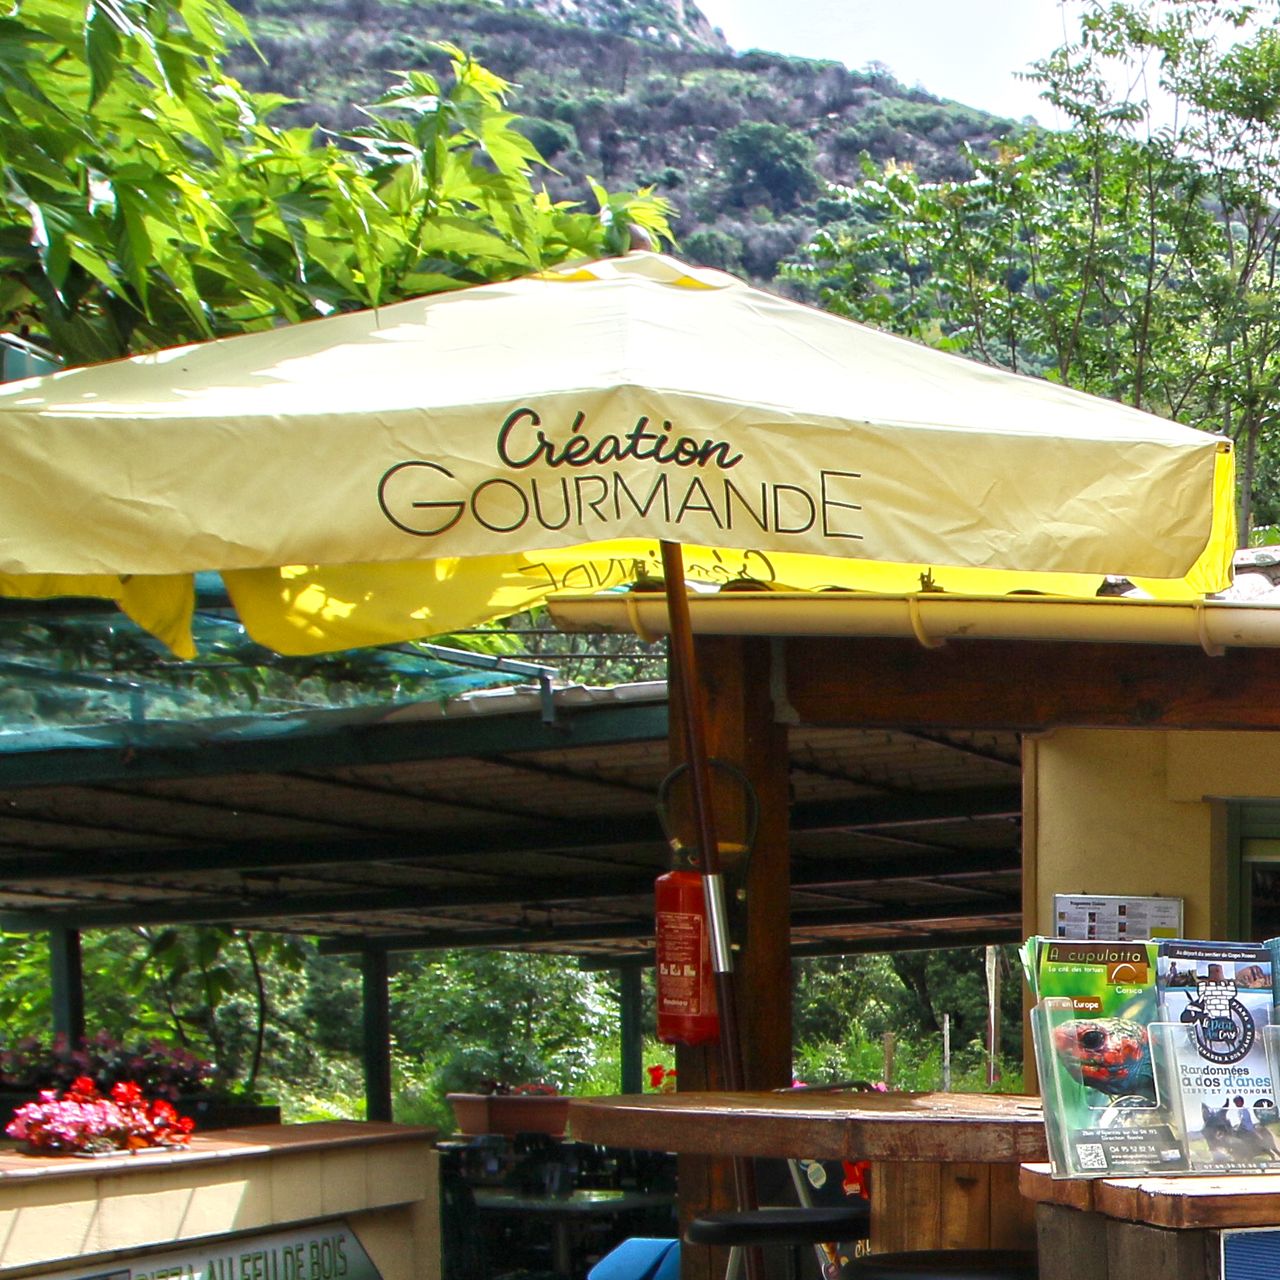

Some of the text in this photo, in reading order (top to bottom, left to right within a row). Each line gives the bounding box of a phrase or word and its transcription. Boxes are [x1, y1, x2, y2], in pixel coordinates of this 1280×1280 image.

[498, 407, 742, 470] Création
[377, 461, 863, 539] GOURMANDE
[1116, 986, 1142, 994] Corsica
[1074, 1000, 1099, 1011] Europe
[1181, 1065, 1249, 1076] Randonnées
[1196, 1076, 1220, 1087] dos
